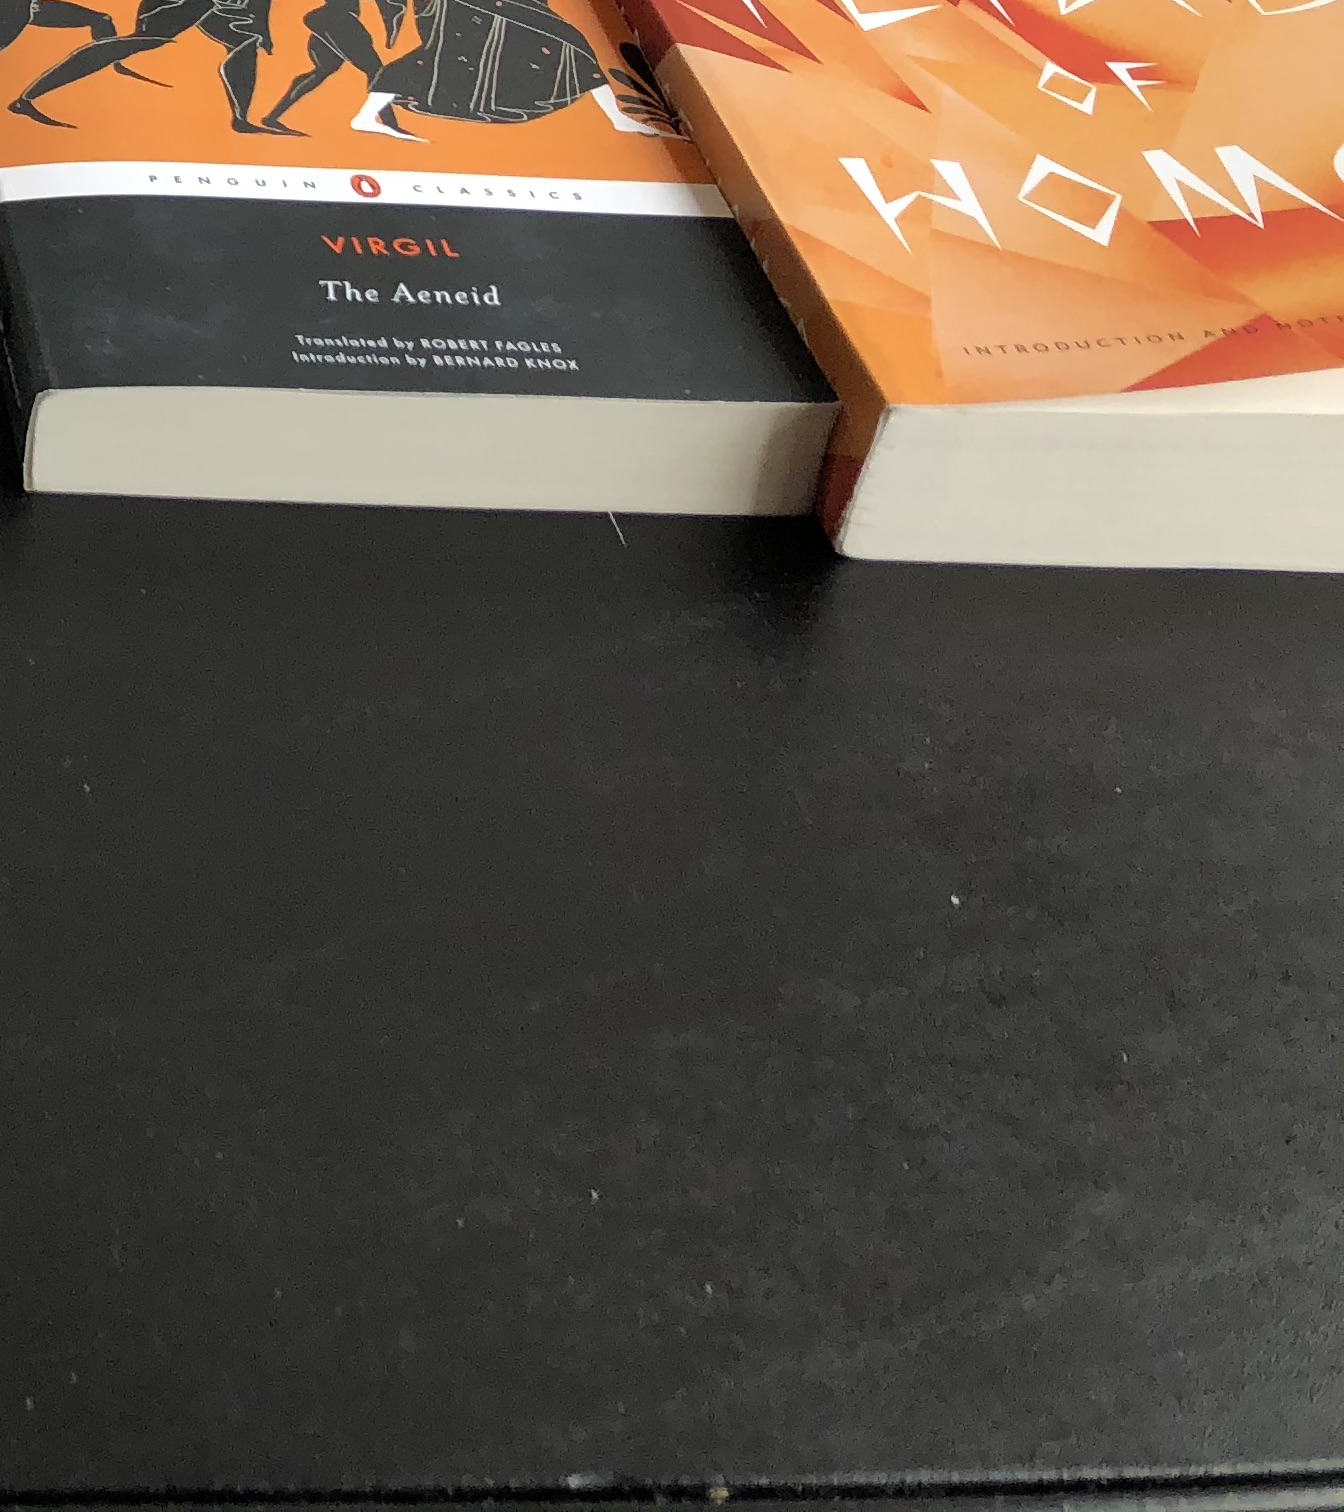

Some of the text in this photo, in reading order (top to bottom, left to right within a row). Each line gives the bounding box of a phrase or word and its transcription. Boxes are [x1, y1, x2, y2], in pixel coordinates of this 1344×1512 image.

[1036, 60, 1168, 116] OF
[148, 173, 584, 202] PENGUIN CLASSICS
[838, 144, 1344, 253] HOM
[321, 234, 461, 260] VIRGIL
[319, 279, 503, 308] The Aeneid
[294, 333, 563, 355] Translated by ROBERT FAGLES
[291, 351, 581, 373] Introduction by BERNARD KNOX
